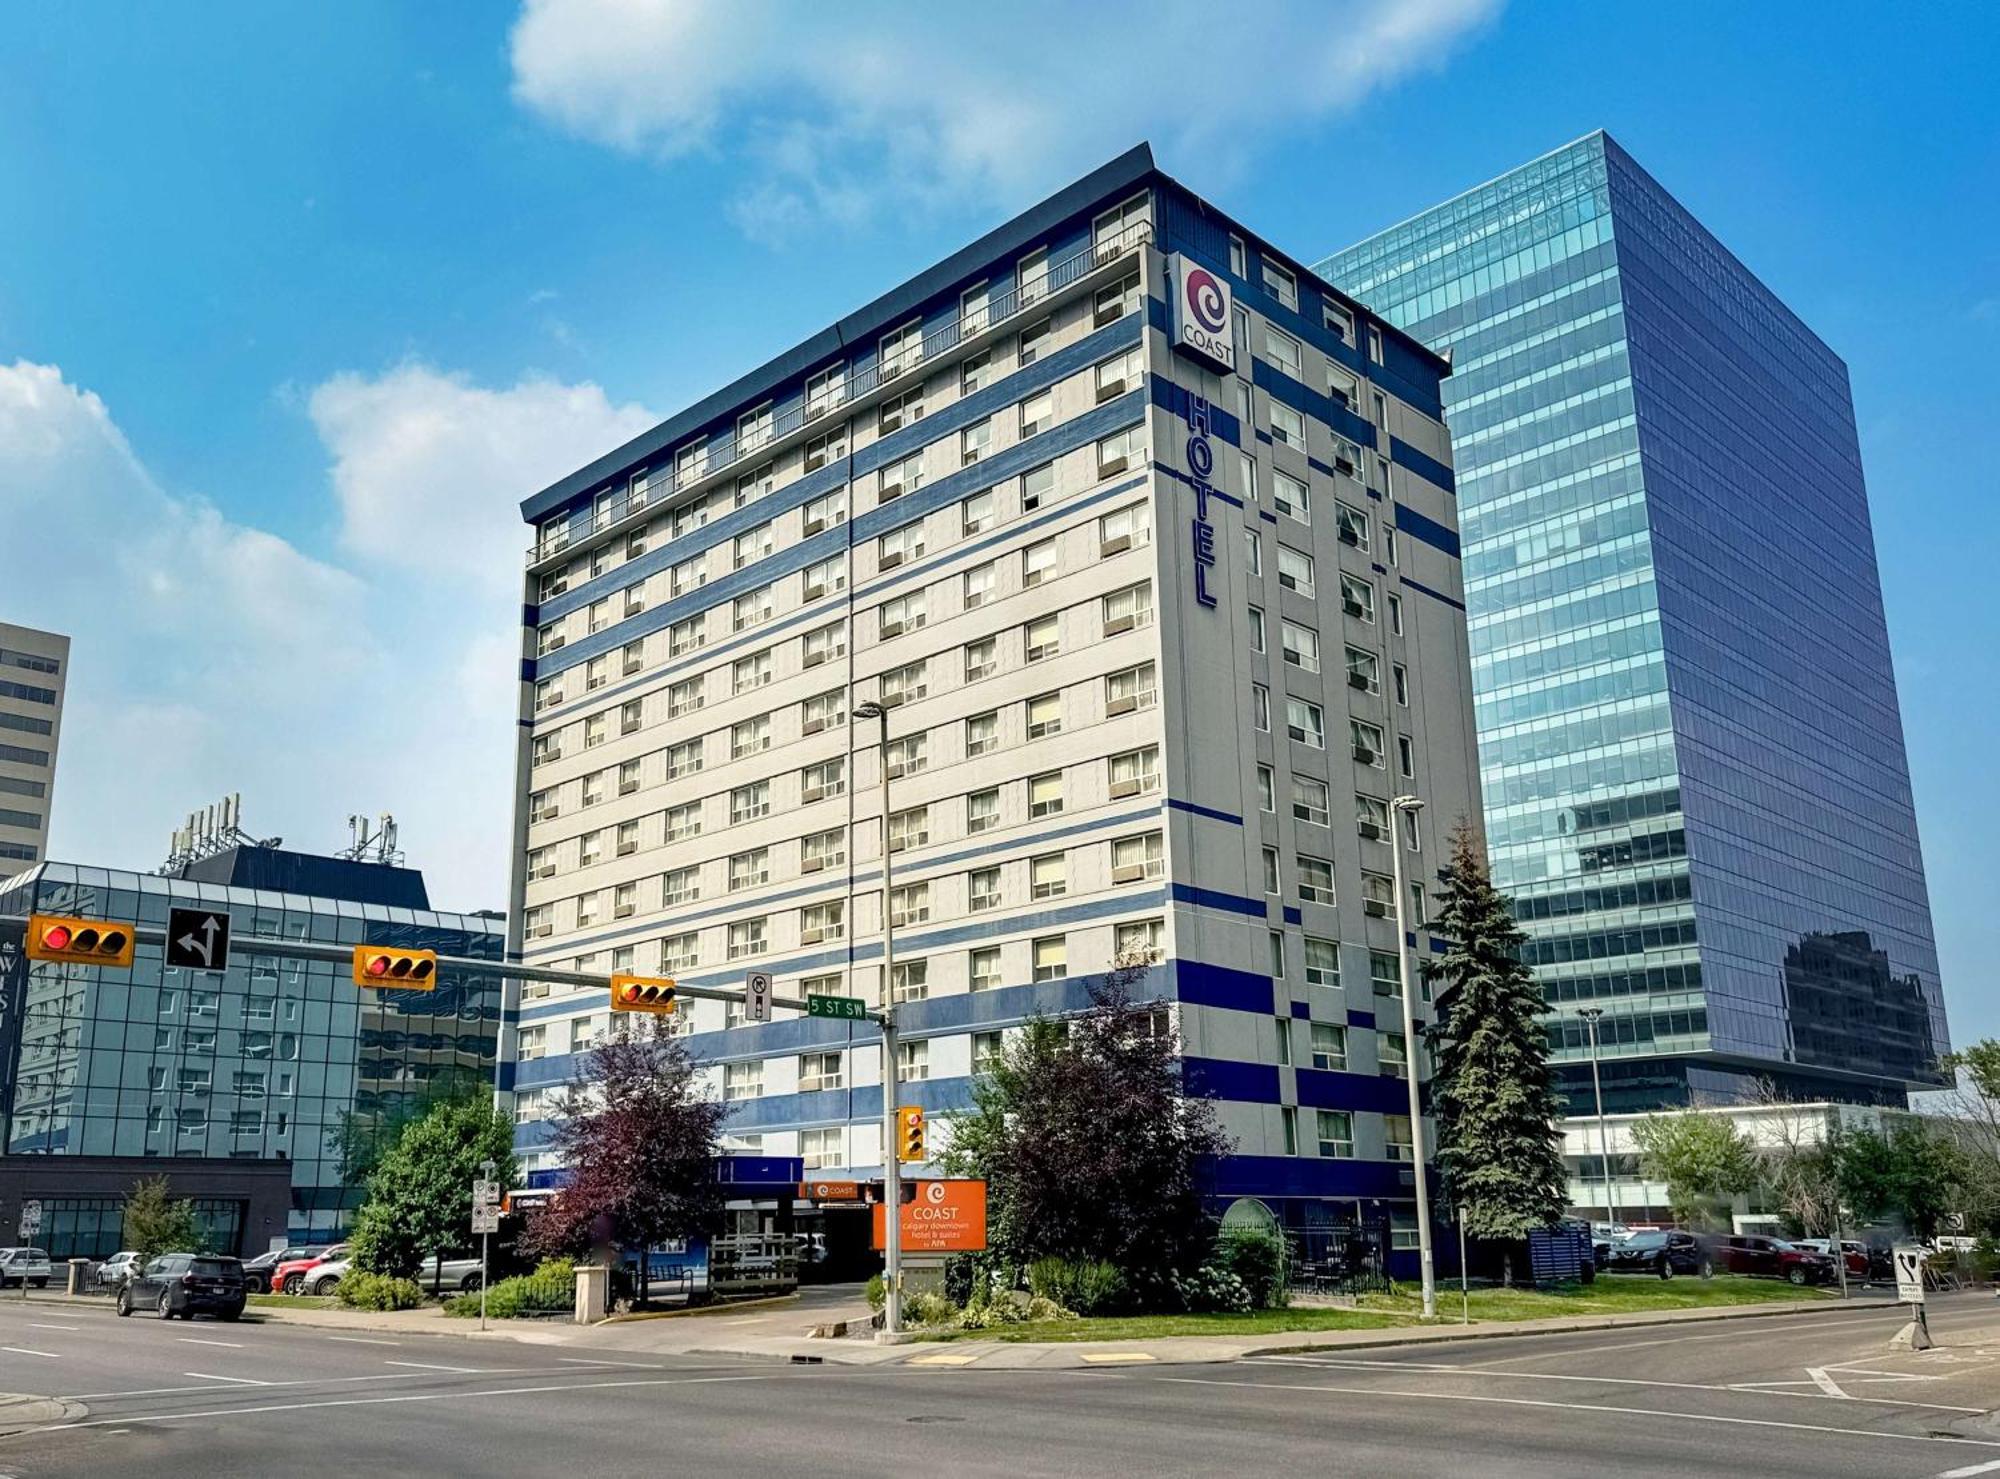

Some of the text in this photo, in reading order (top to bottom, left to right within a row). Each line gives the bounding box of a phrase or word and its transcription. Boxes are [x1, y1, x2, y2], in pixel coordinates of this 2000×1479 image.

[1183, 324, 1232, 363] COAST
[1186, 390, 1218, 608] HOTEL
[3, 941, 16, 950] the
[811, 1000, 863, 1016] 5 ST SW
[913, 1207, 960, 1220] COAST
[912, 1231, 931, 1239] hotel
[939, 1231, 961, 1239] suites
